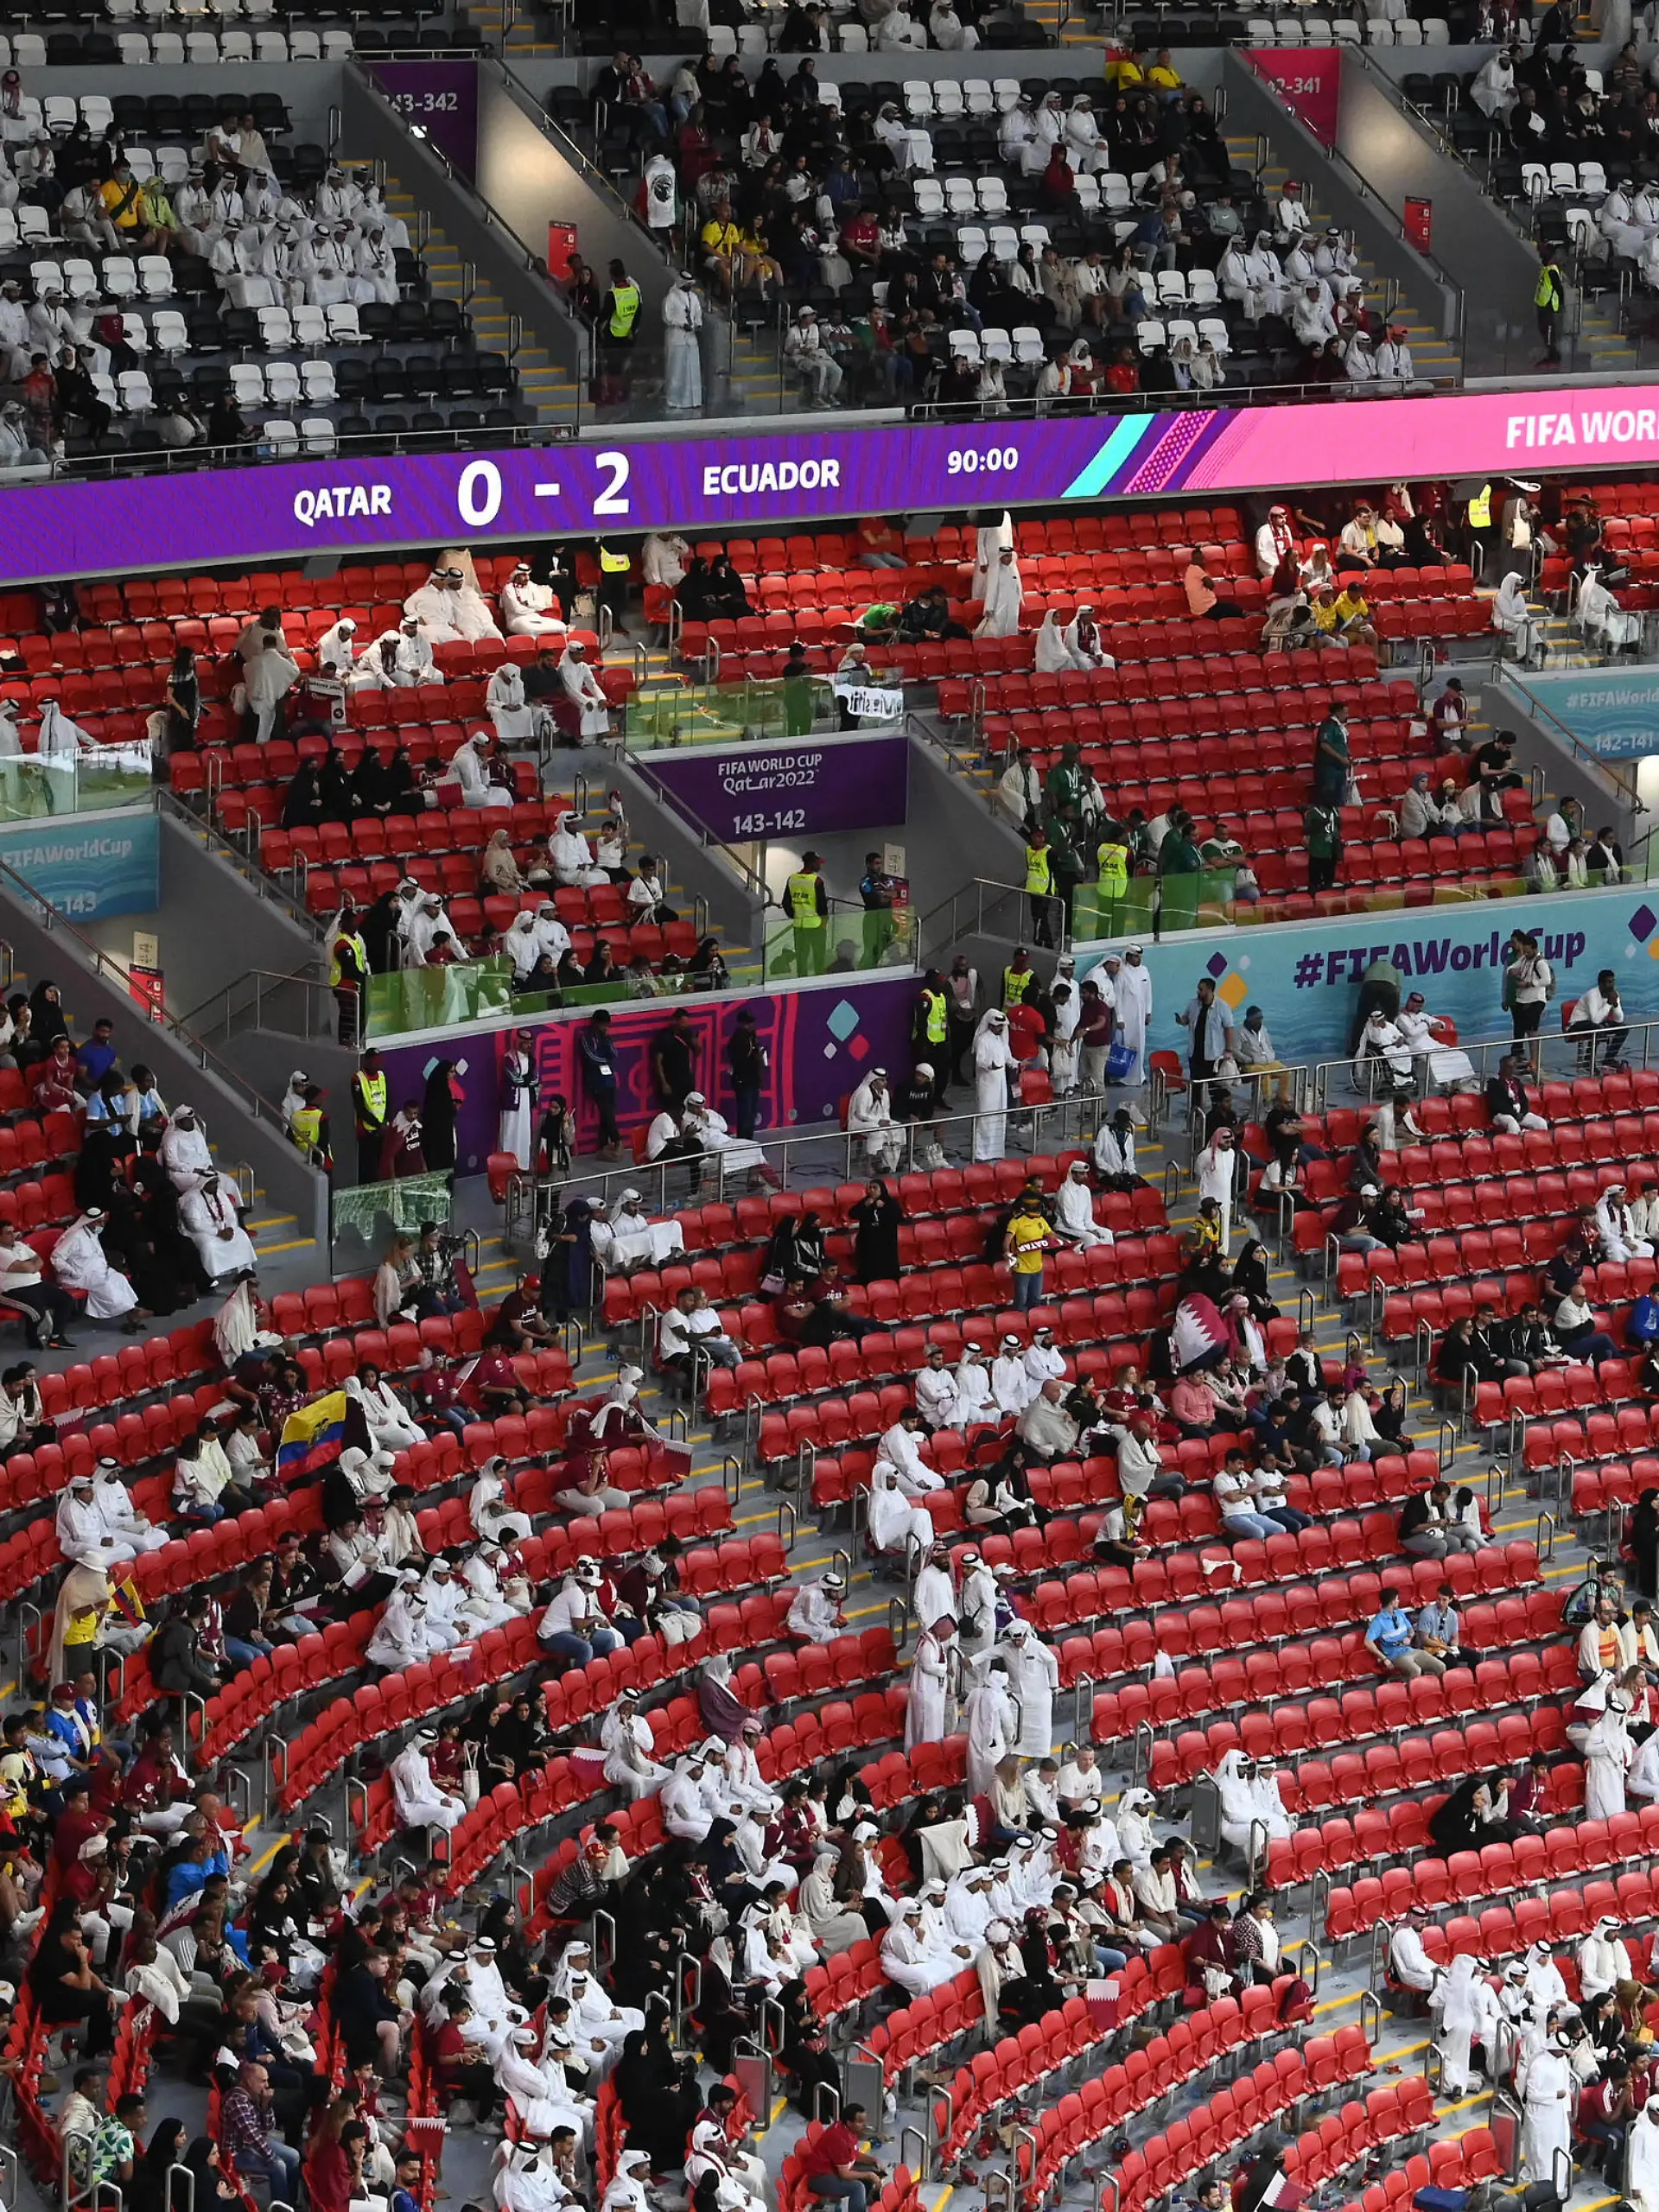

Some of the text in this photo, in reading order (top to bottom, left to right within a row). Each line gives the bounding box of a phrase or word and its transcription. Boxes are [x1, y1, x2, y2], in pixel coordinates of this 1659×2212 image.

[1506, 409, 1659, 448] FIFA WOR
[294, 447, 1019, 526] QATAR 0 - 2 ECUADOR 90:00
[1595, 731, 1654, 752] 142-141
[718, 753, 823, 776] FIFA WORLD CUP
[734, 809, 805, 835] 143-142
